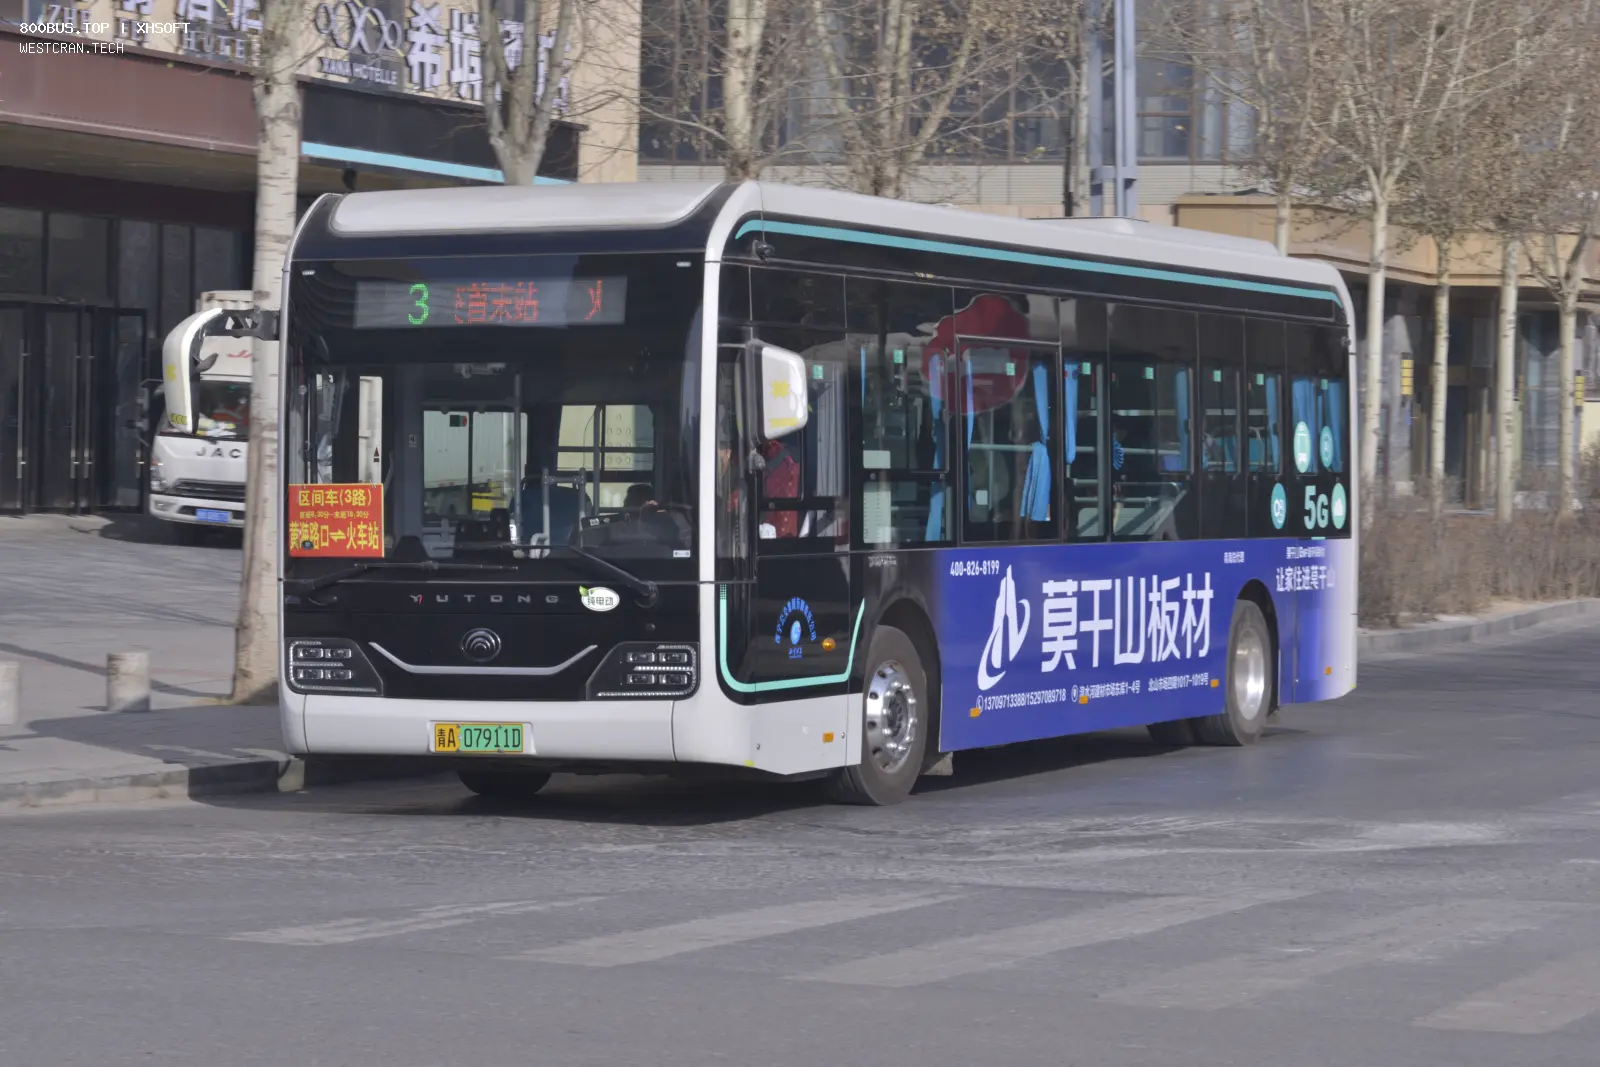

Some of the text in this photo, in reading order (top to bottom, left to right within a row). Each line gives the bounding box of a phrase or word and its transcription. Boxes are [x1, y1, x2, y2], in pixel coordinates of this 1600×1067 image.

[408, 283, 429, 325] 3
[196, 447, 243, 459] JAC
[298, 489, 372, 506] 区间车(3路)
[1304, 485, 1329, 530] 5G
[346, 520, 380, 550] 火车站
[950, 559, 1000, 577] 400-826-8199
[409, 594, 559, 604] YUTONG
[1041, 572, 1214, 673] 莫干山板材
